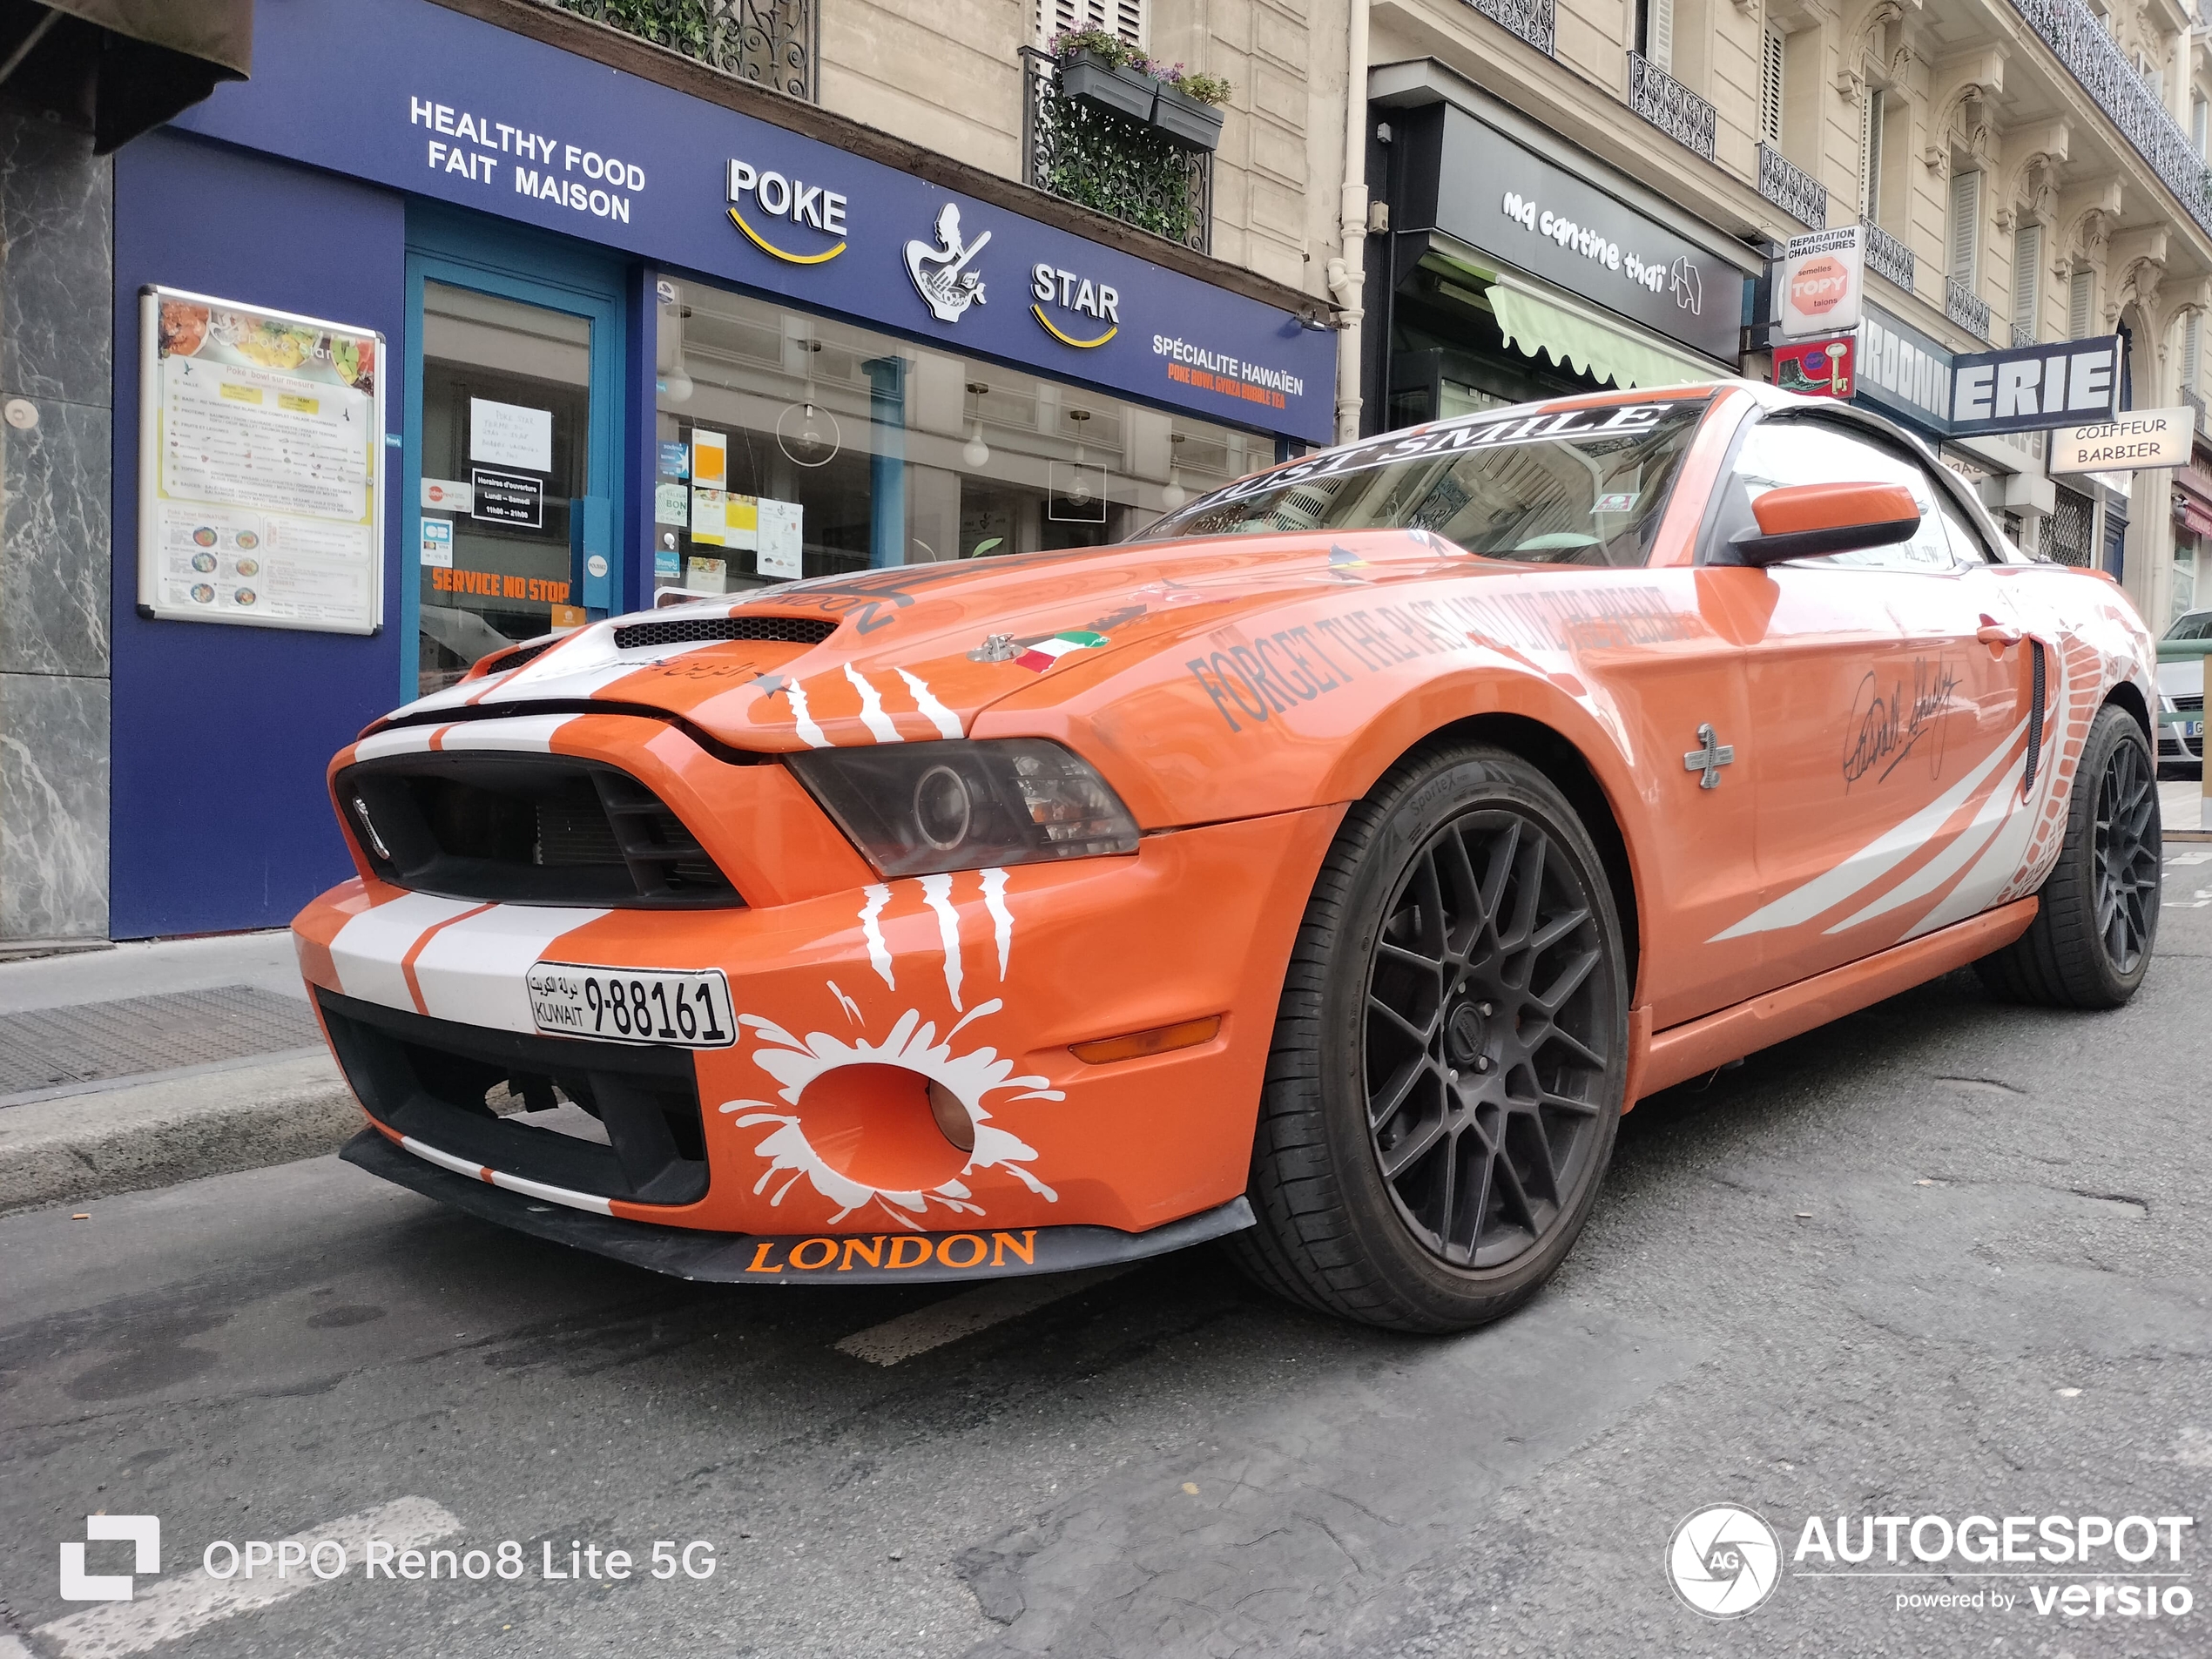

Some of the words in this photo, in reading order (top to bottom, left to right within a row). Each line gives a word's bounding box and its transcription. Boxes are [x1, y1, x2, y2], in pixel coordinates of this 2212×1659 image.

[410, 97, 557, 164] HEALTHY
[564, 144, 644, 192] FOOD
[428, 140, 496, 185] FAIT
[516, 165, 631, 224] MAISON
[726, 158, 847, 237] POKE
[1502, 192, 1535, 231] ma
[1539, 211, 1620, 271] cantine
[1622, 252, 1667, 293] thaï
[1788, 239, 1856, 260] CHAUSSURES
[1790, 228, 1855, 249] REPARATION
[1797, 265, 1832, 276] semelles
[1030, 263, 1120, 324] STAR
[1792, 275, 1847, 298] TOPY
[1814, 297, 1838, 307] talons
[1152, 334, 1238, 377] SPÉCIALITE
[1242, 361, 1304, 396] HAWAÏEN
[251, 368, 270, 381] bowl
[272, 374, 284, 385] sur
[287, 376, 314, 390] mesure
[1168, 362, 1190, 383] POKE
[1190, 368, 1215, 390] BOWL
[1215, 376, 1240, 397] GYOZA
[1242, 383, 1271, 405] BUBBLE
[1271, 392, 1285, 409] TEA
[2075, 418, 2167, 440] COIFFEUR
[1185, 445, 1378, 513] JUST
[1377, 403, 1675, 460] SMILE
[2078, 442, 2161, 462] BARBIER
[477, 476, 503, 488] Horaires
[503, 479, 537, 494] d'ouverture
[484, 491, 502, 502] Lundi
[508, 496, 530, 505] Samedi
[486, 506, 504, 516] 11h00
[509, 509, 529, 519] 21h00
[425, 525, 448, 539] CB
[432, 567, 500, 597] SERVICE
[502, 576, 526, 599] NO
[529, 578, 570, 604] STOP
[1185, 624, 1340, 733] FORGET
[1313, 610, 1420, 683] THE
[1374, 599, 1467, 654] PAST
[529, 975, 556, 997] الكويت
[558, 976, 578, 1000] دولة
[534, 1001, 583, 1028] KUWAIT
[584, 976, 726, 1041] 9-88161
[745, 1230, 1037, 1273] LONDON
